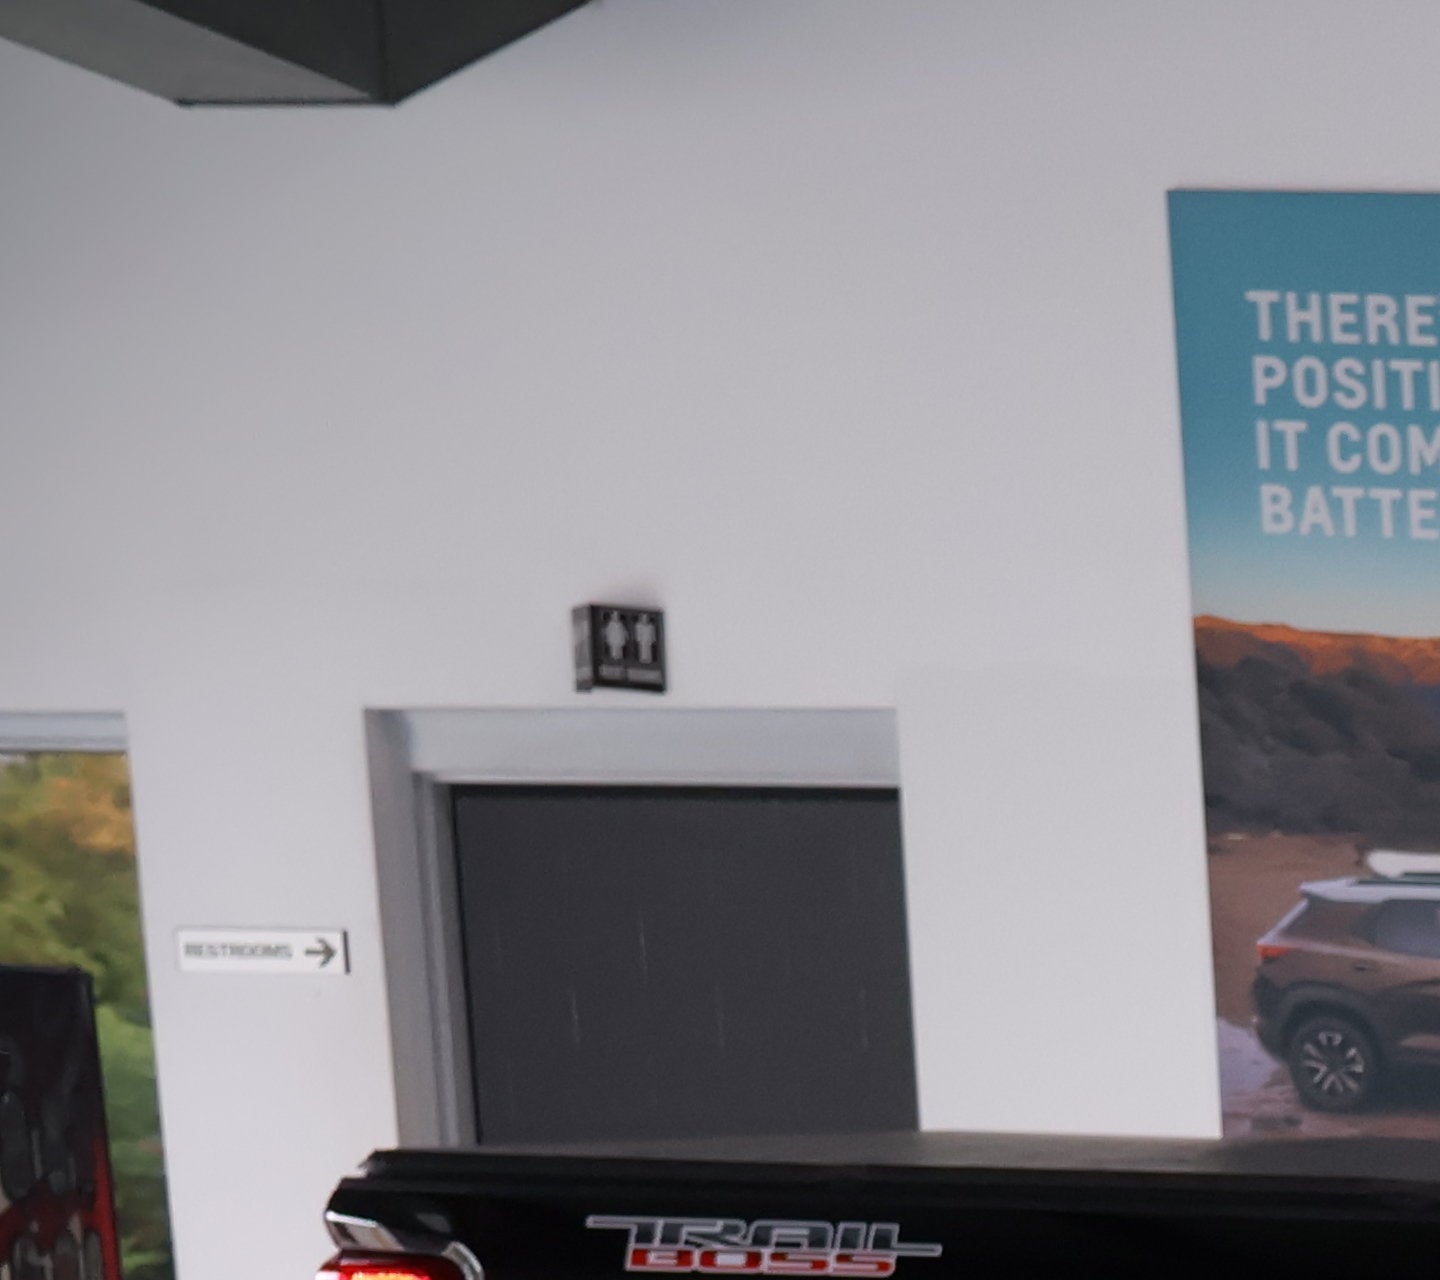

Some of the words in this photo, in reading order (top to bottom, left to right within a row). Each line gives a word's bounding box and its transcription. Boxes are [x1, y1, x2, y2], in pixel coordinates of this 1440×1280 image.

[1257, 421, 1307, 471] IT
[585, 1214, 943, 1257] TRAIL
[624, 1246, 896, 1278] BOSS
